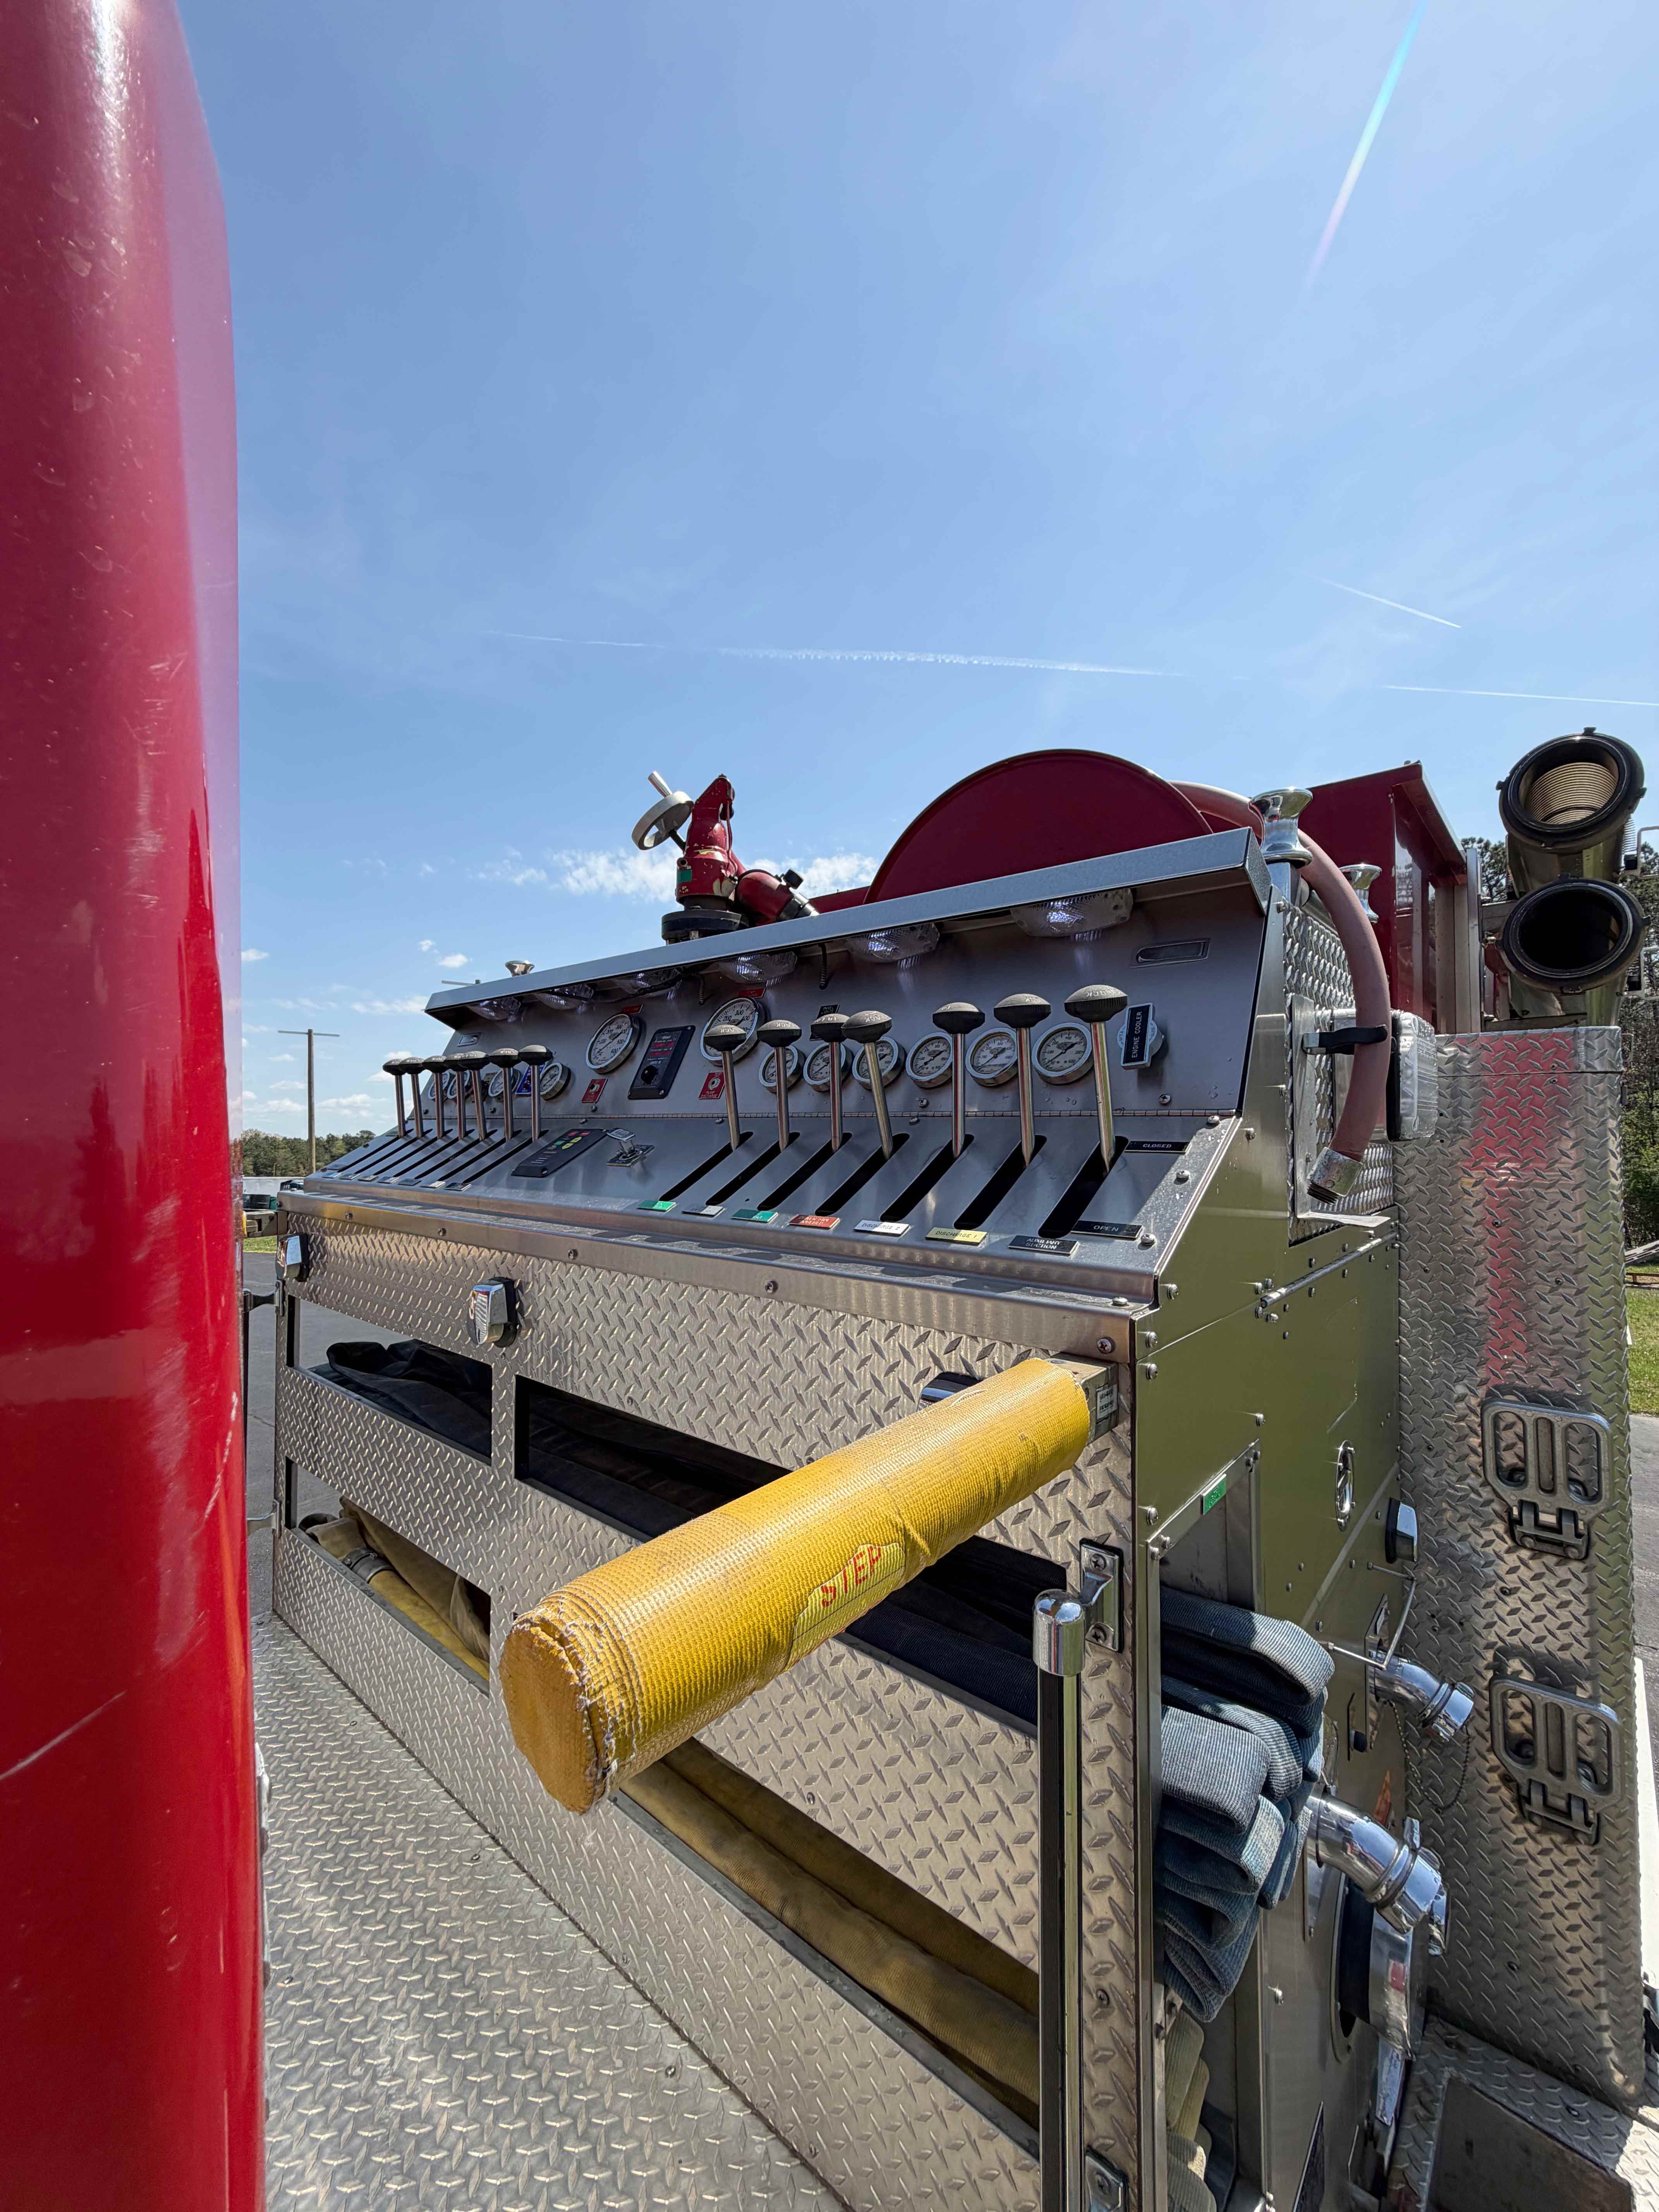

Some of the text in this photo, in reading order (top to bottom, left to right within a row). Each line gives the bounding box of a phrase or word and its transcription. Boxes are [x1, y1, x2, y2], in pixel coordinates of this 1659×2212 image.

[1131, 1011, 1142, 1058] ENGINE COOLER
[935, 1230, 971, 1238] DISCHARGE
